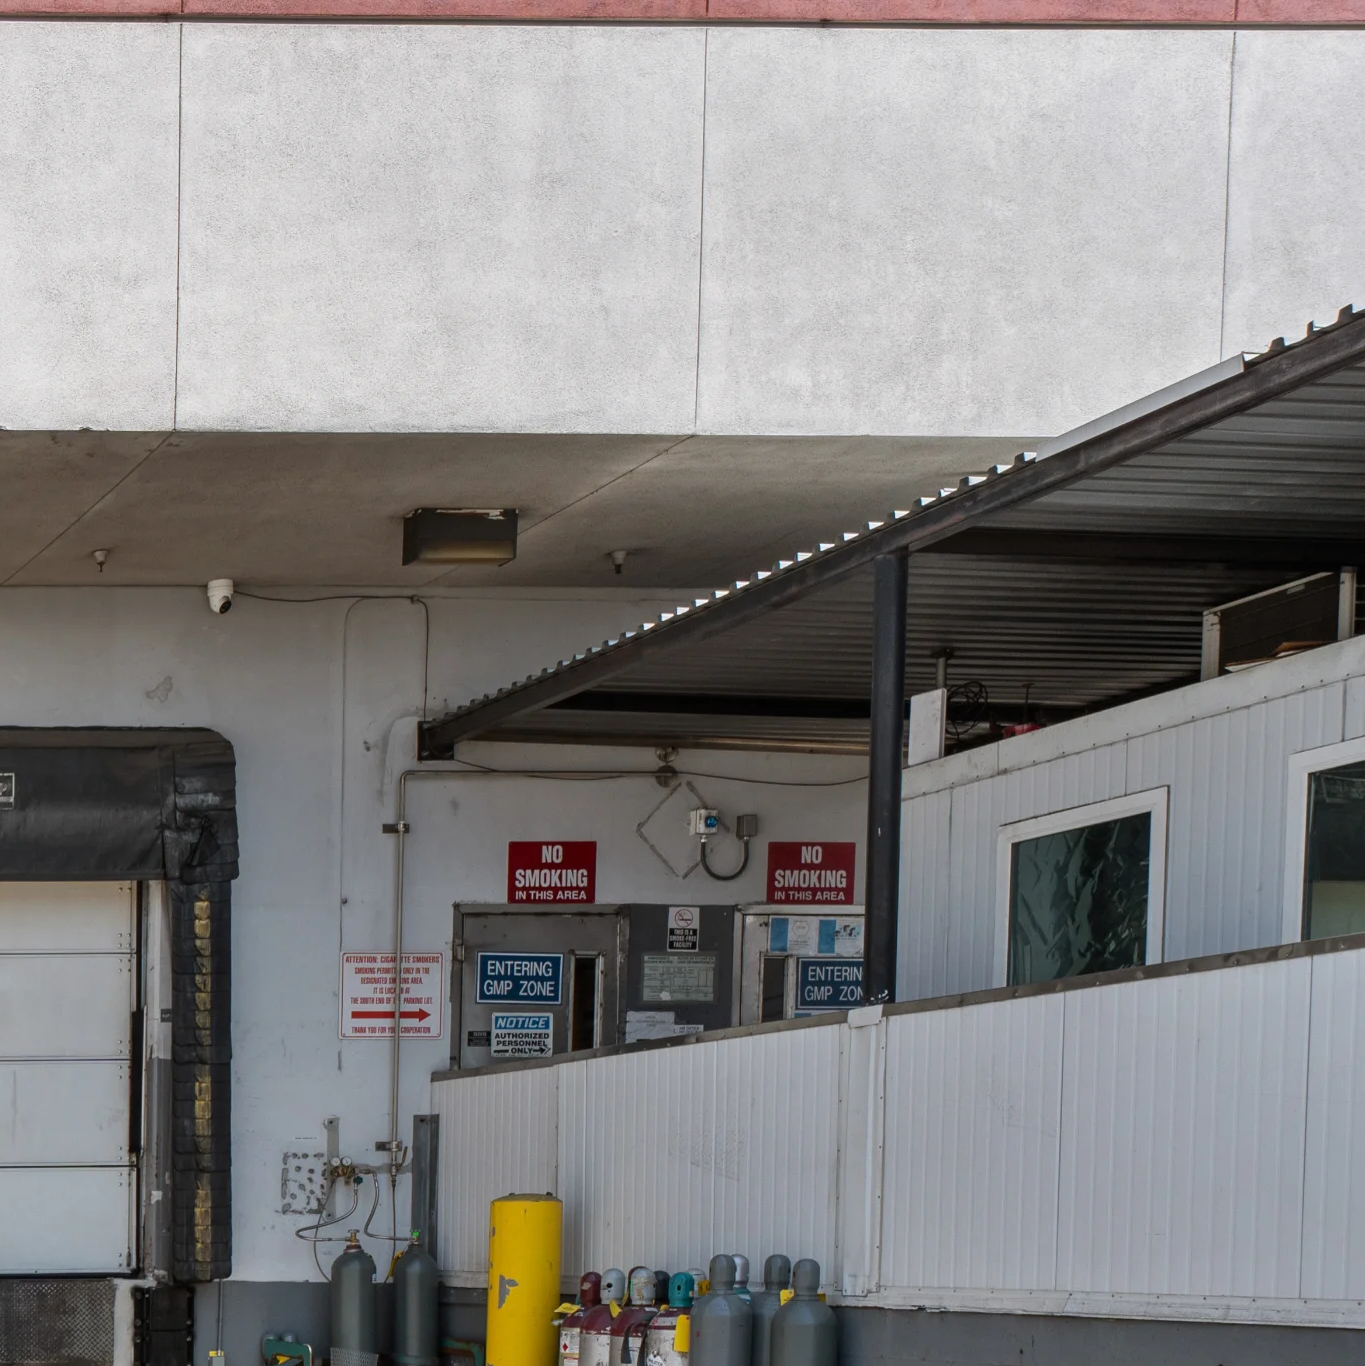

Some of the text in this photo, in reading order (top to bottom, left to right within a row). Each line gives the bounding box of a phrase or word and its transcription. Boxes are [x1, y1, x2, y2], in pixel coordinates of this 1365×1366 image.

[541, 845, 563, 863] NO
[800, 846, 822, 864] NO
[515, 869, 588, 887] SMOKING
[774, 869, 847, 888] SMOKING
[515, 890, 587, 900] IN THIS AREA
[774, 891, 845, 900] IN THIS AREA
[345, 956, 378, 964] ATTENTION:
[487, 960, 553, 977] ENTERING
[808, 966, 863, 981] ENTERIN
[483, 980, 555, 997] GMP ZONE
[804, 986, 863, 1001] GMP ZON
[496, 1017, 547, 1028] NOTICE
